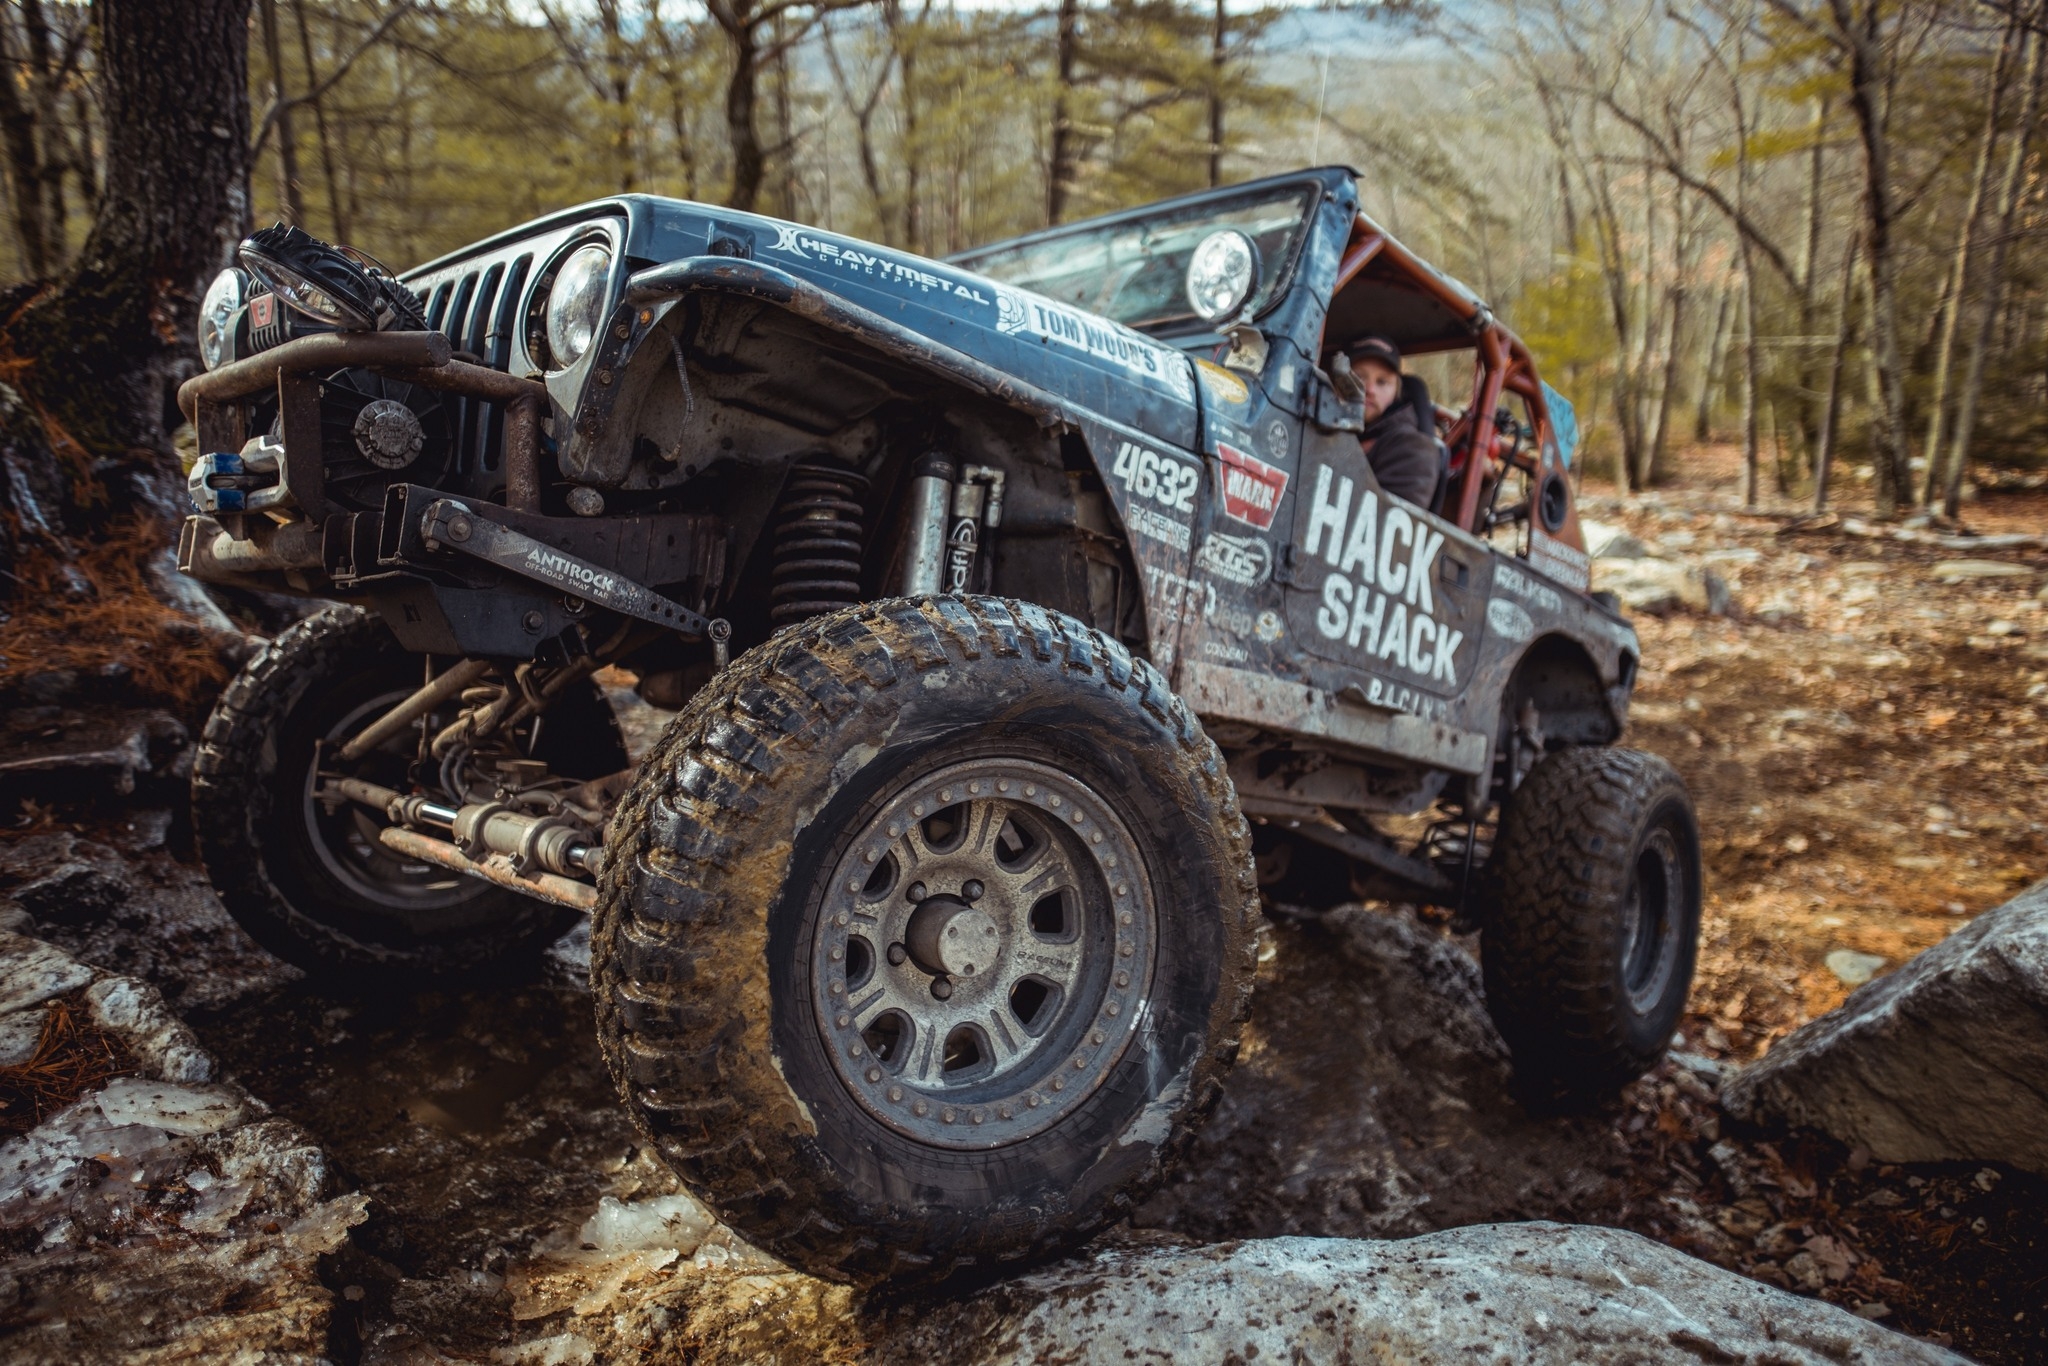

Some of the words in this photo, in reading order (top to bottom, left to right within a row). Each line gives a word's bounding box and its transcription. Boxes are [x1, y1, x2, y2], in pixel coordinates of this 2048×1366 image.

[819, 253, 929, 293] CONCEPTS
[1034, 304, 1081, 344] TOM
[1113, 441, 1199, 514] 4632
[1227, 469, 1276, 512] WARN
[1305, 463, 1445, 615] HACK
[524, 561, 564, 581] OFF-ROAD
[567, 578, 590, 592] SWAY
[593, 588, 609, 600] BAR
[527, 548, 614, 591] ANTIROCK
[1209, 598, 1252, 640] Jeep
[1317, 573, 1464, 687] SHACK
